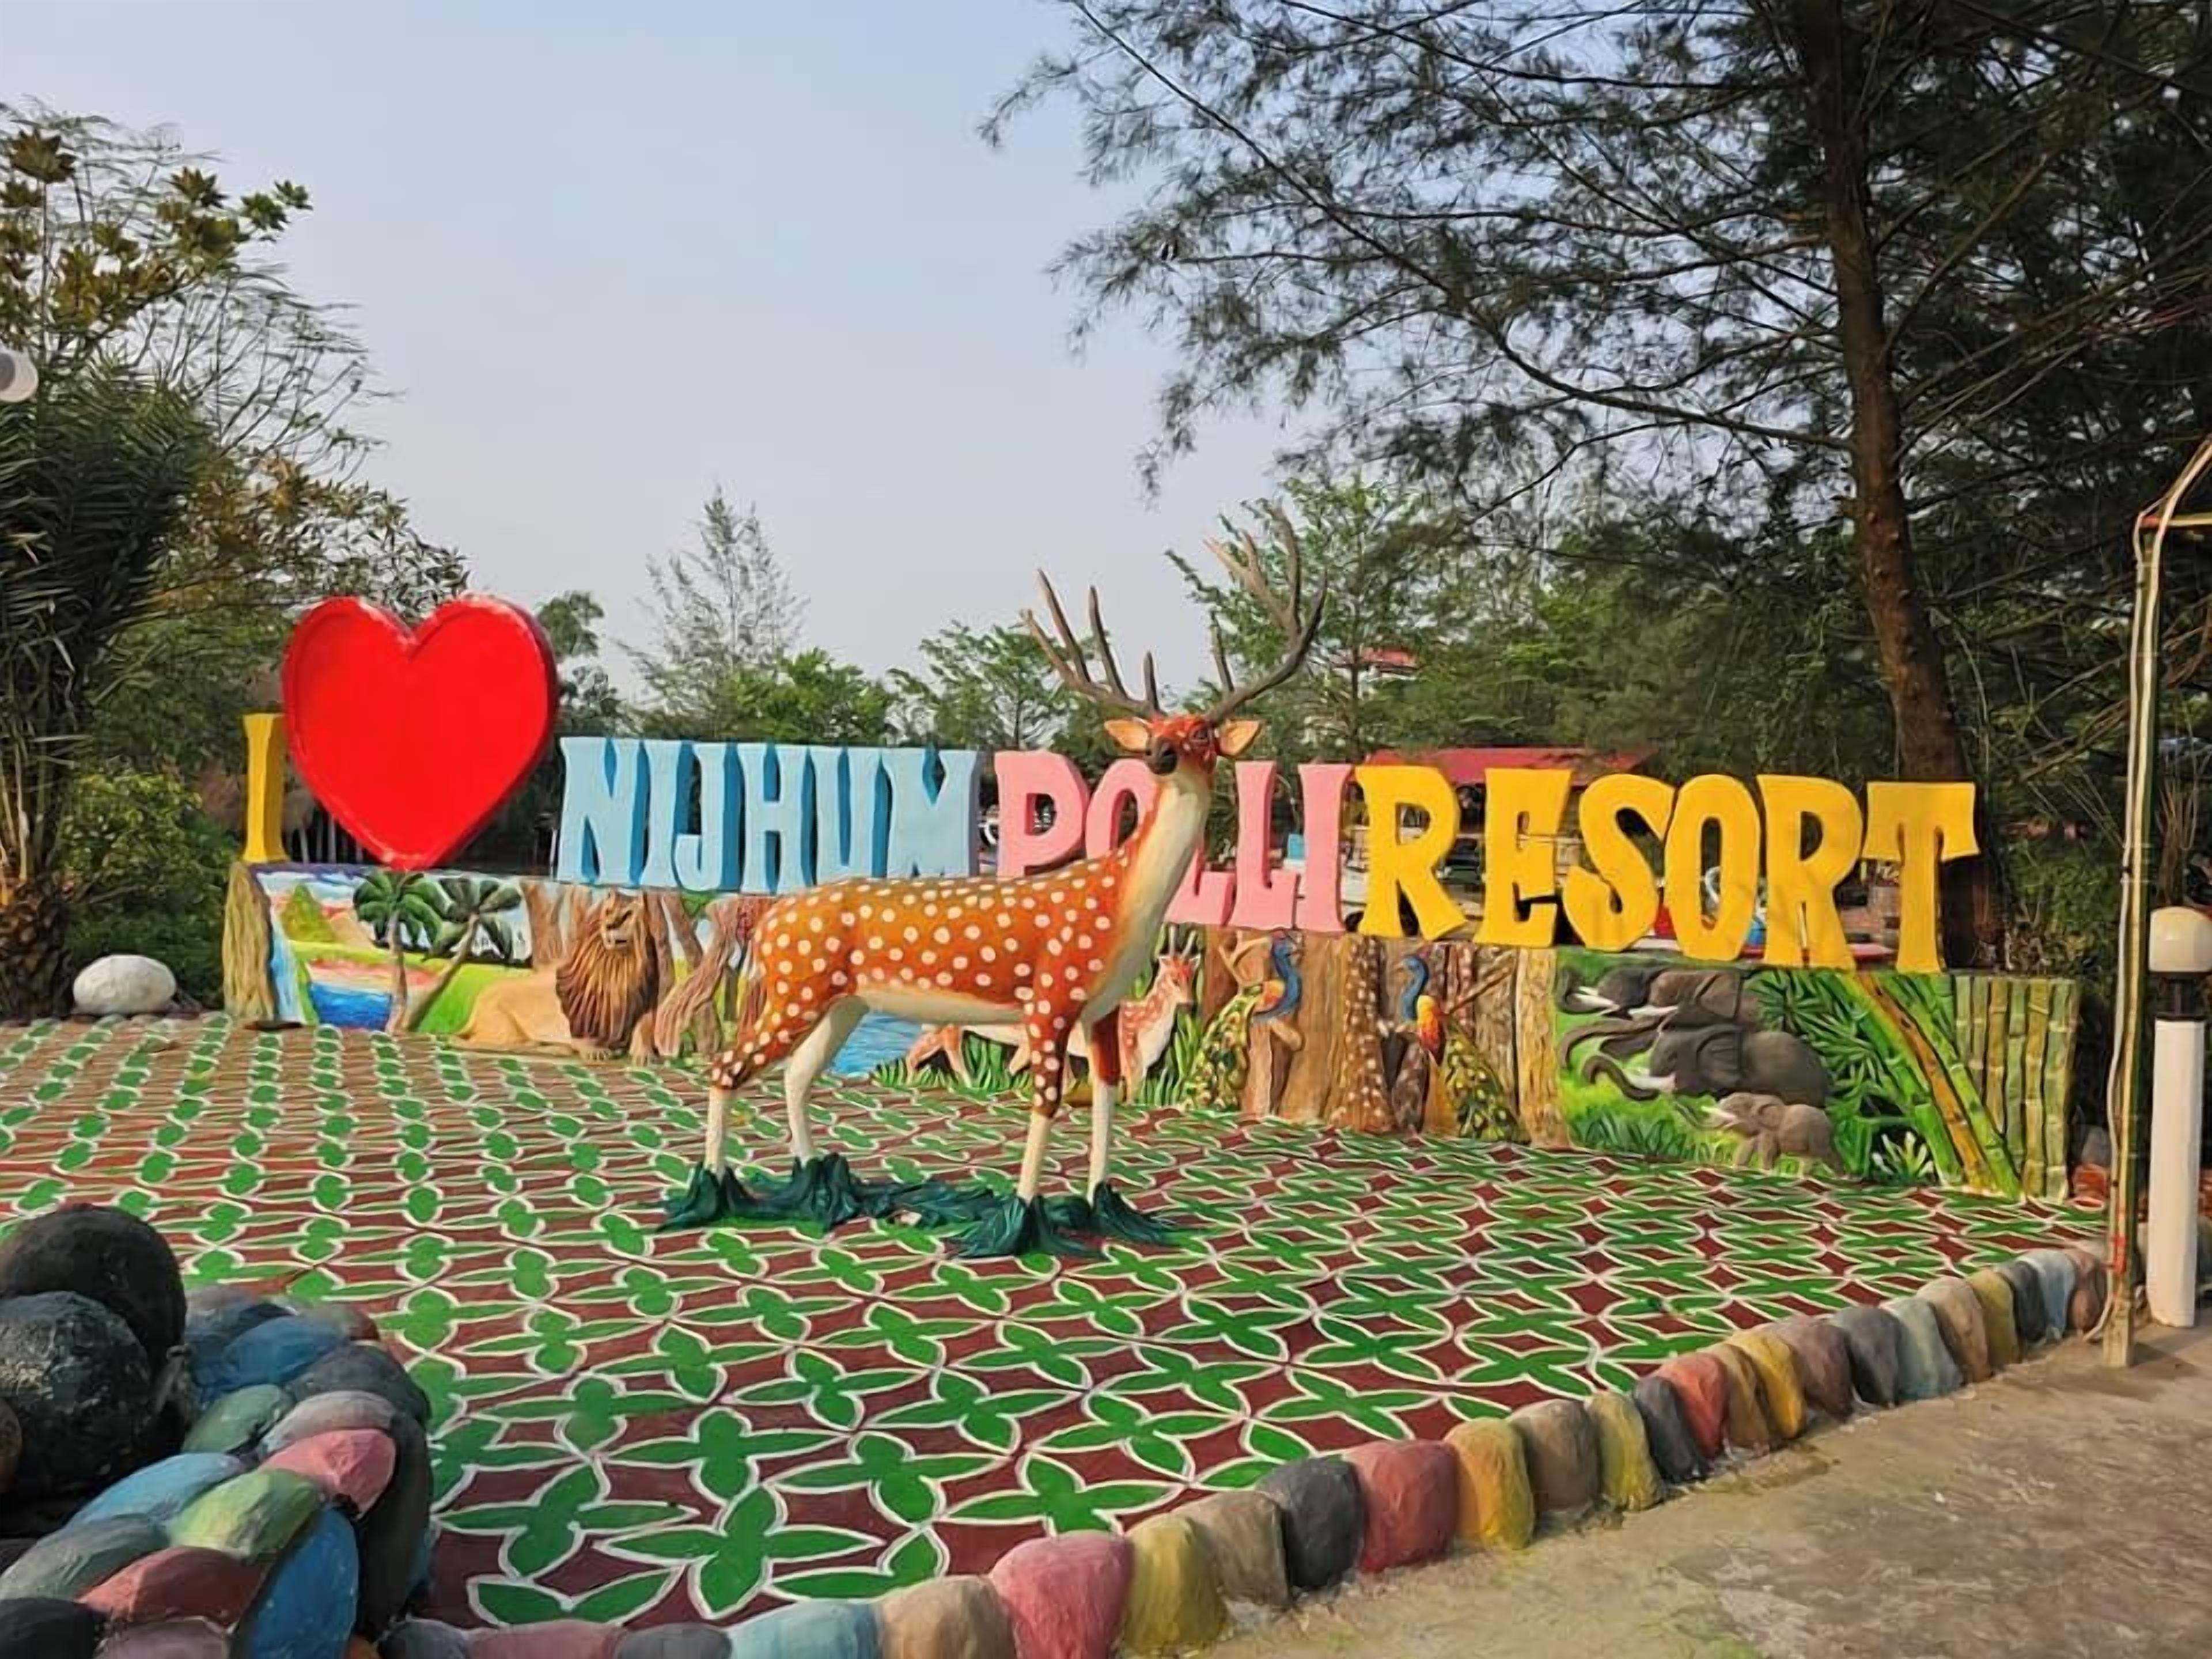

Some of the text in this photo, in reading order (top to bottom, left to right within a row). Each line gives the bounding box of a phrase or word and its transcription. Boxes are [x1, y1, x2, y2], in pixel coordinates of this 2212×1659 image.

[243, 713, 287, 863] I
[556, 736, 981, 895] NIJHUM
[1355, 764, 1980, 974] RESORT
